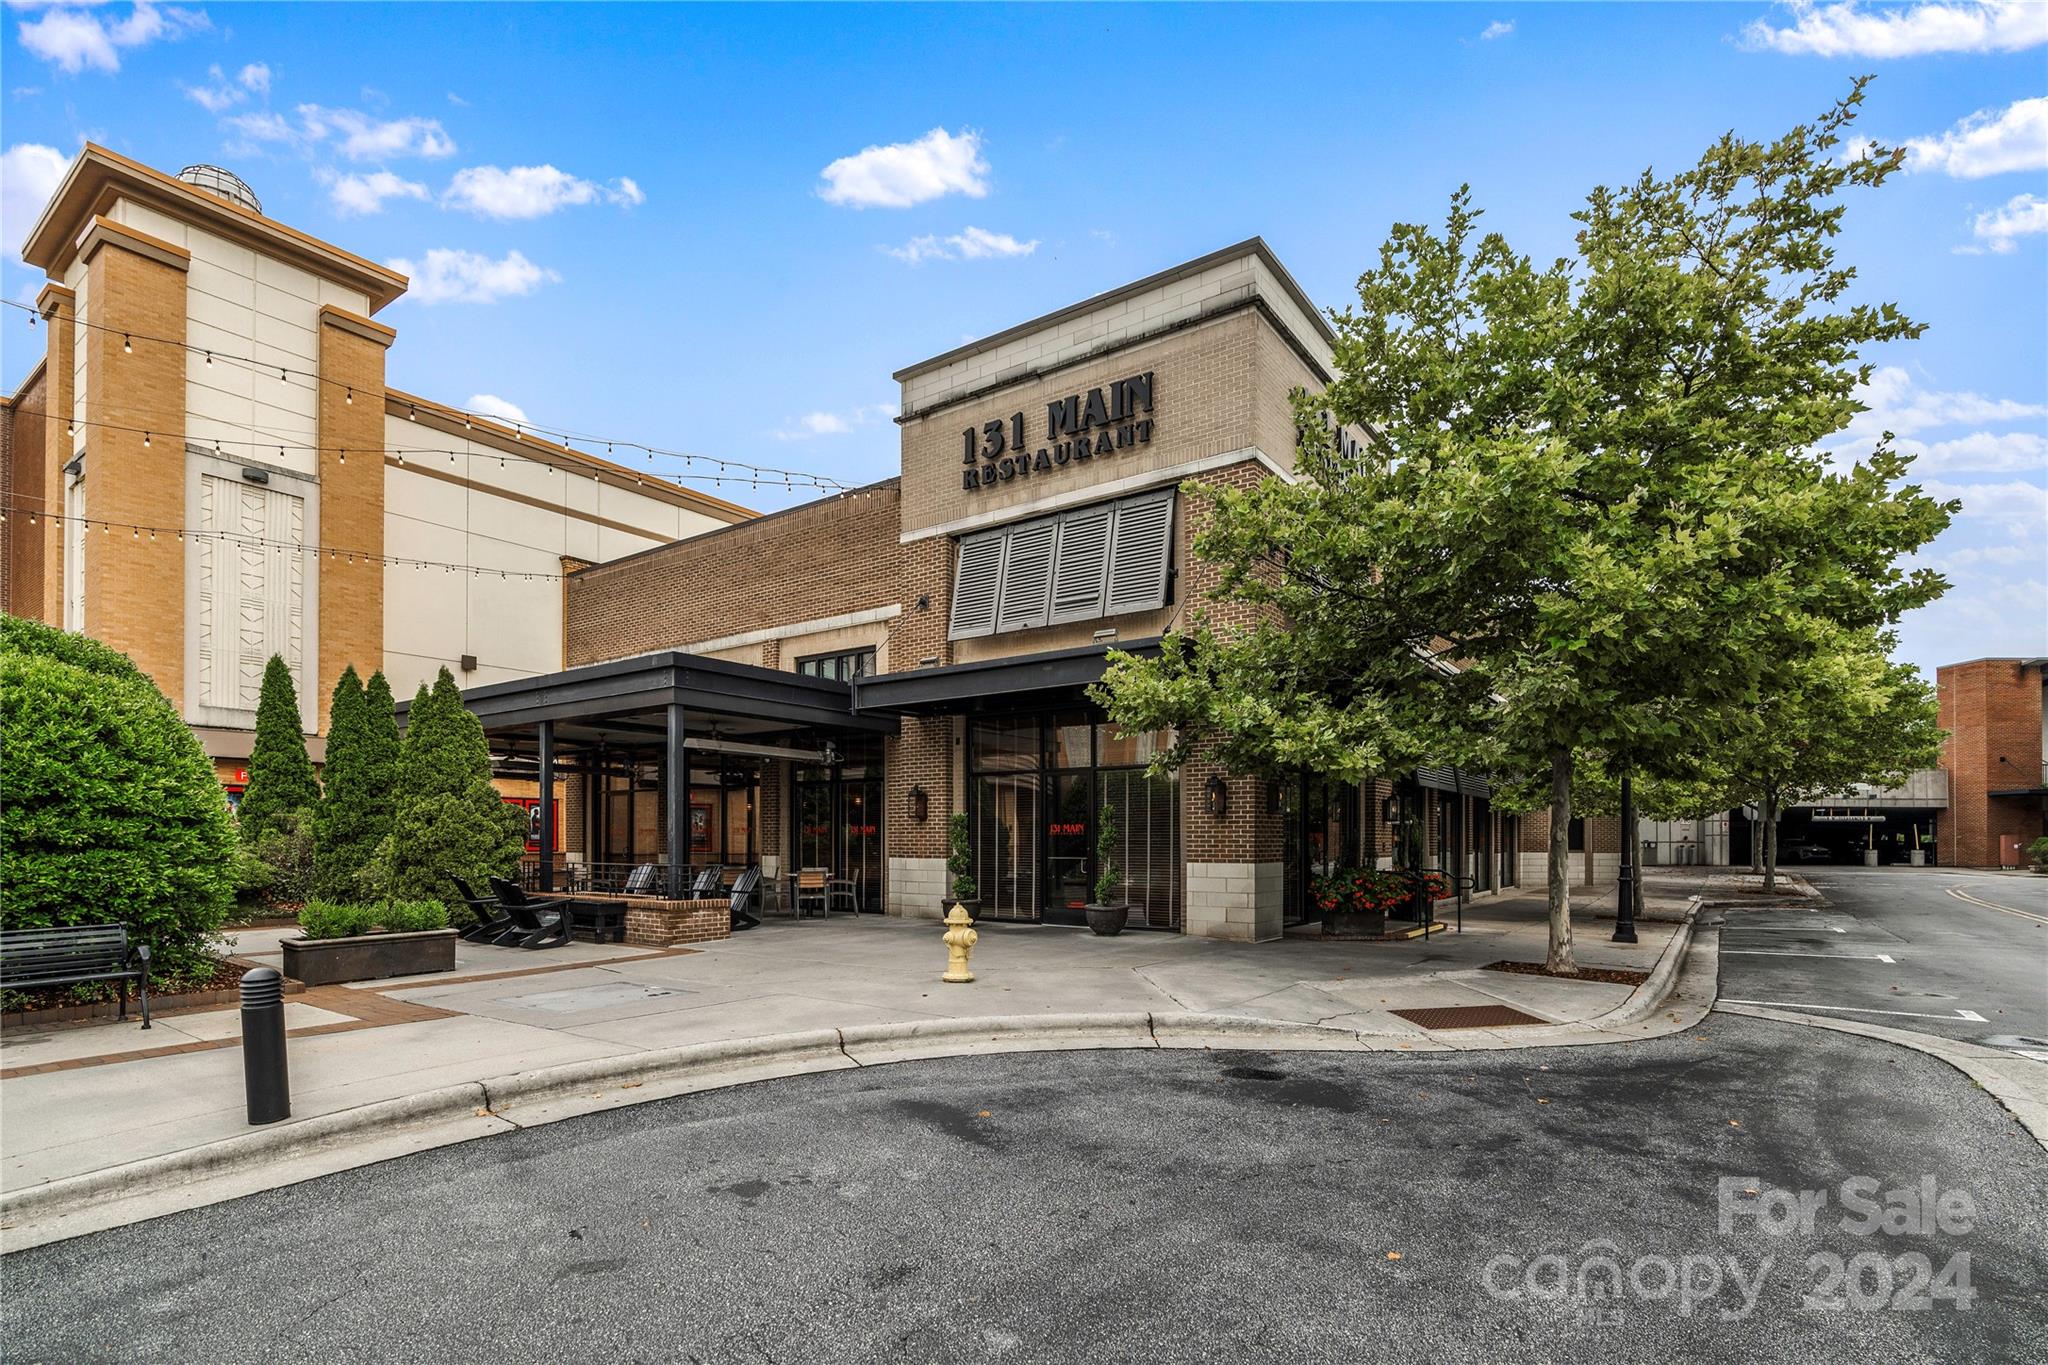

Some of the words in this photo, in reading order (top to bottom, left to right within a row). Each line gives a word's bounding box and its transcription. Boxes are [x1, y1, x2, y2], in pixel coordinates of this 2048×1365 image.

[962, 411, 1025, 465] 131
[1047, 371, 1155, 440] MAIN
[962, 417, 1155, 490] RESTAURANT
[1050, 823, 1061, 833] 131
[1062, 823, 1085, 833] MAIN
